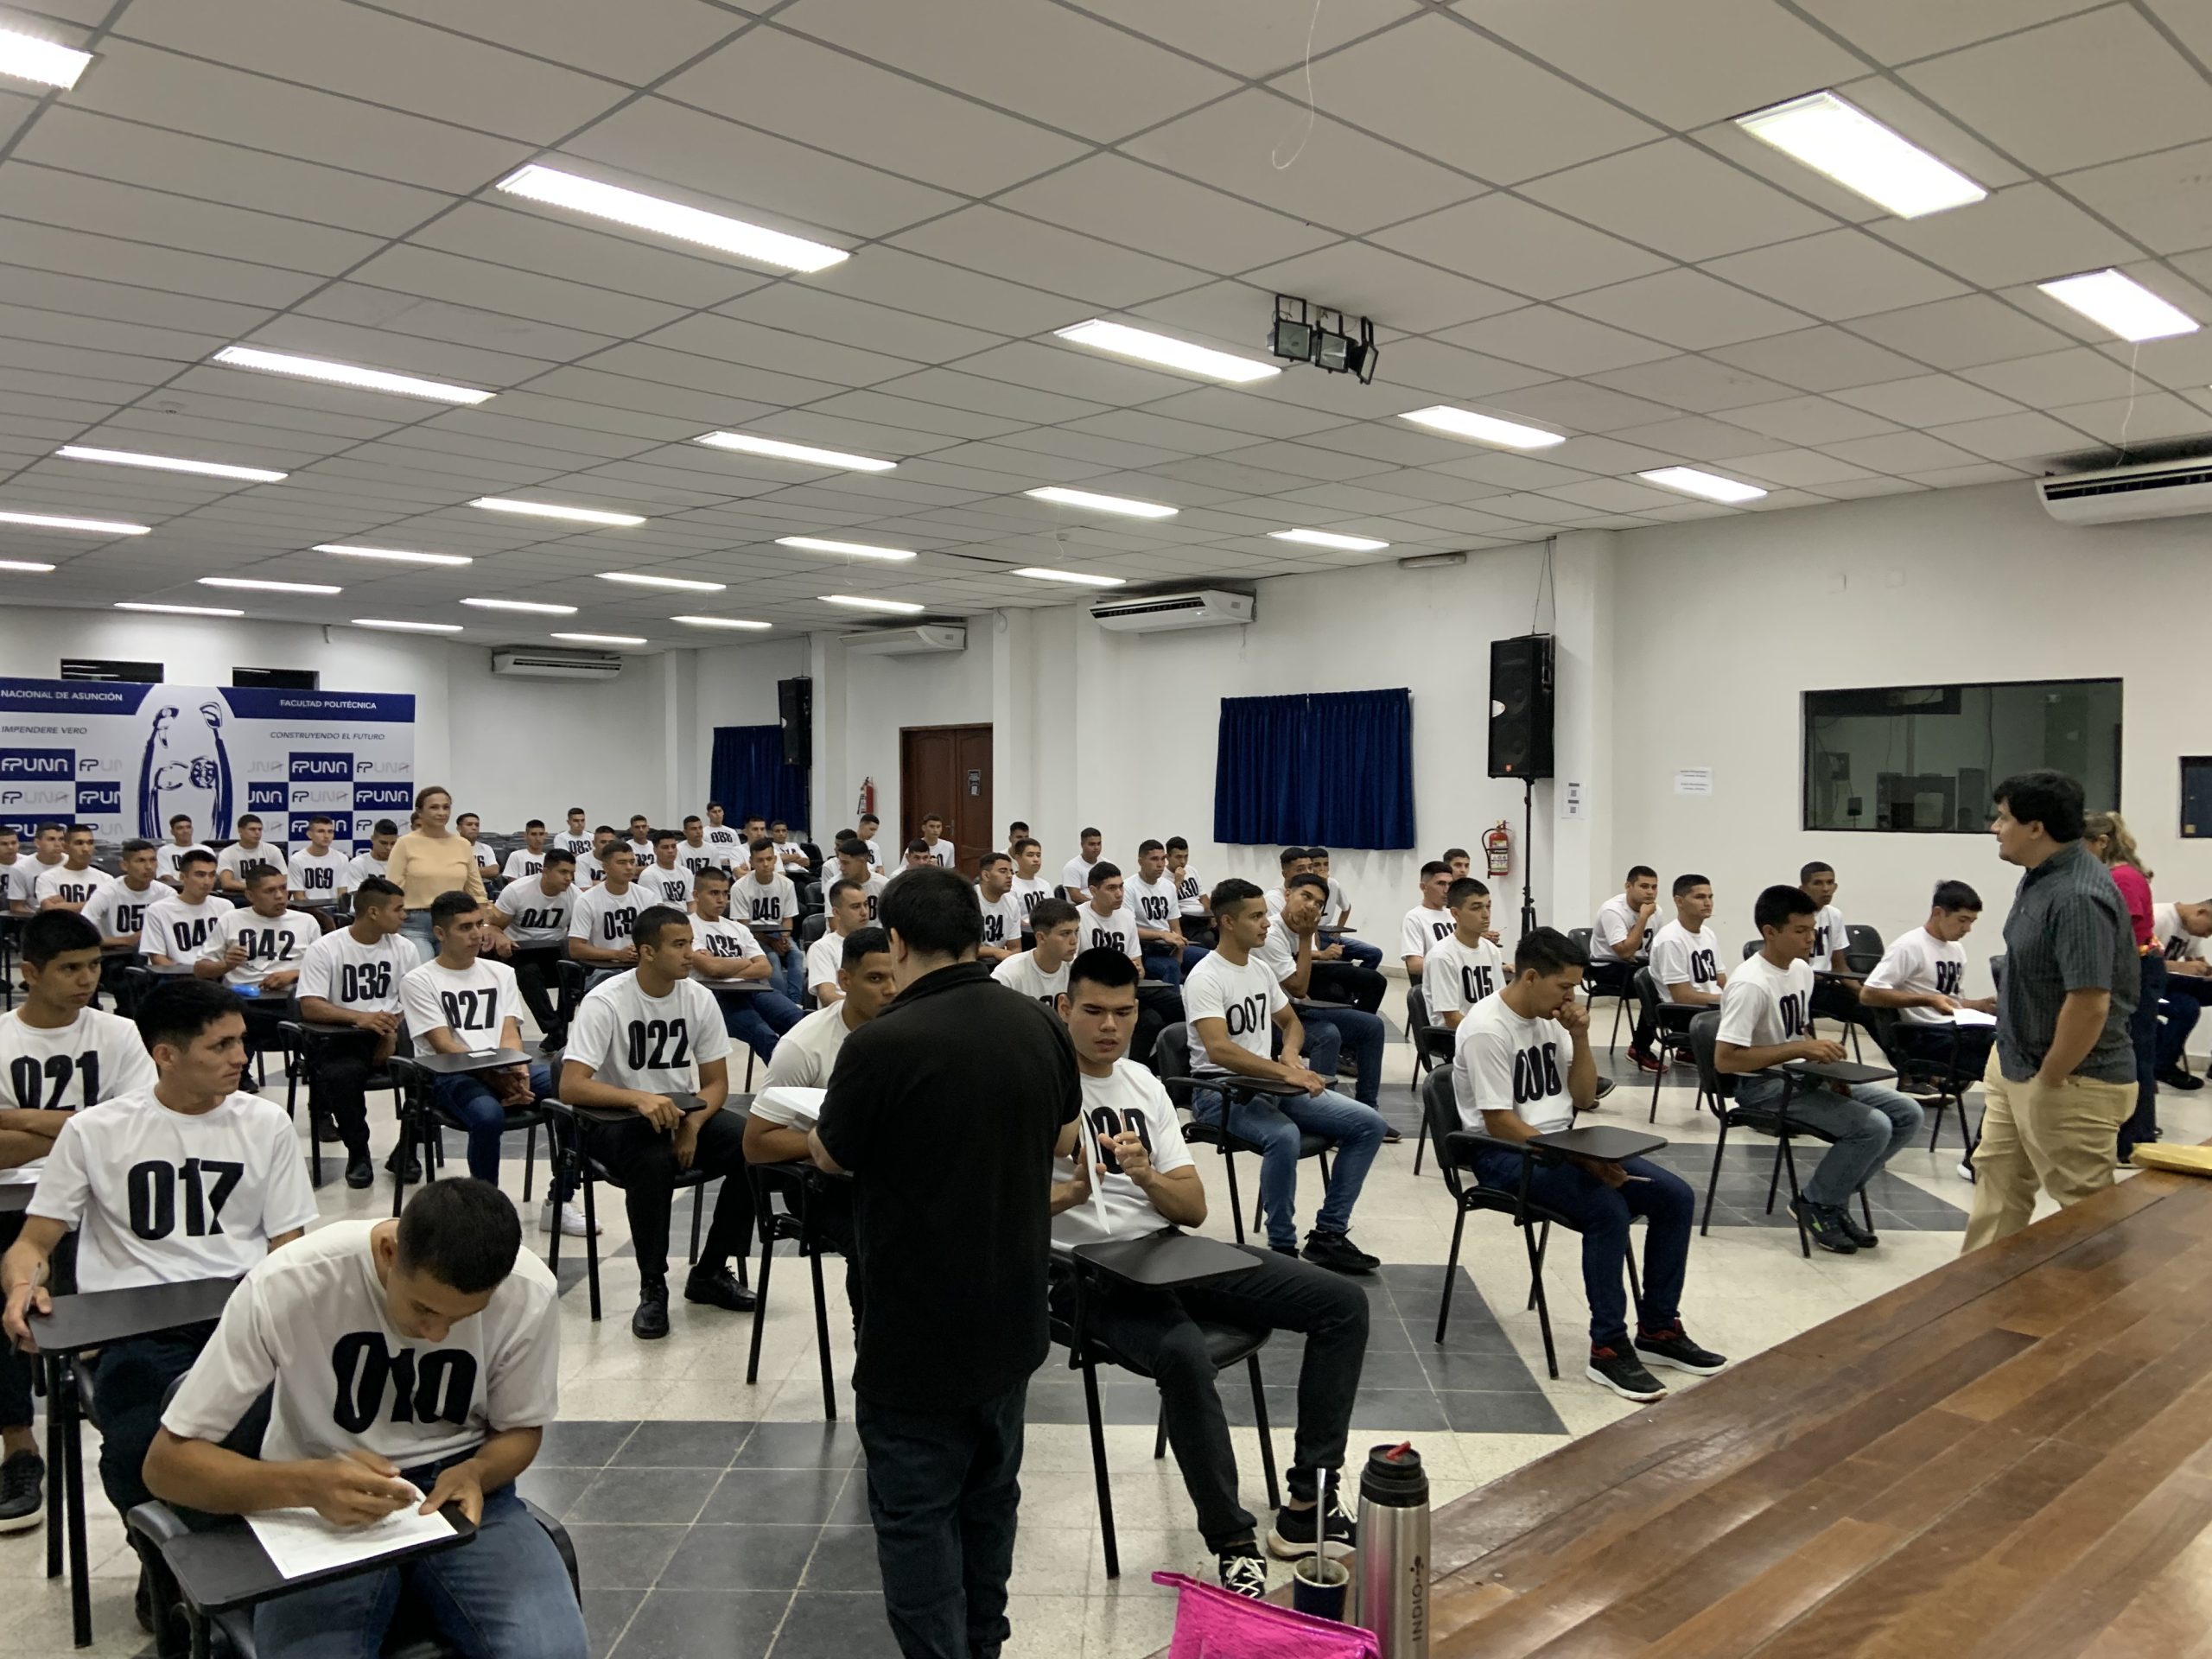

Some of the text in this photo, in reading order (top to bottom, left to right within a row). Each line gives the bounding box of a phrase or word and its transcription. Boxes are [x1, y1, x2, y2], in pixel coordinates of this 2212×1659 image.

[1, 690, 53, 699] NACIONAL
[72, 691, 123, 702] ASUNCIÓN
[280, 699, 377, 709] FACULTAD POLITÉCNICA
[304, 868, 334, 889] 069
[753, 896, 780, 921] 046
[982, 914, 1003, 943] 34
[1141, 896, 1169, 920] 033
[238, 928, 296, 961] 042
[341, 961, 391, 1002] 036
[1462, 964, 1493, 1003] 015
[442, 988, 498, 1030] 027
[1226, 993, 1267, 1035] 007
[628, 1018, 690, 1071] 022
[10, 1050, 100, 1110] 021
[1513, 1042, 1562, 1104] 006
[128, 1158, 245, 1241] 017
[332, 1331, 477, 1434] 010
[1412, 1583, 1423, 1642] INDIO
